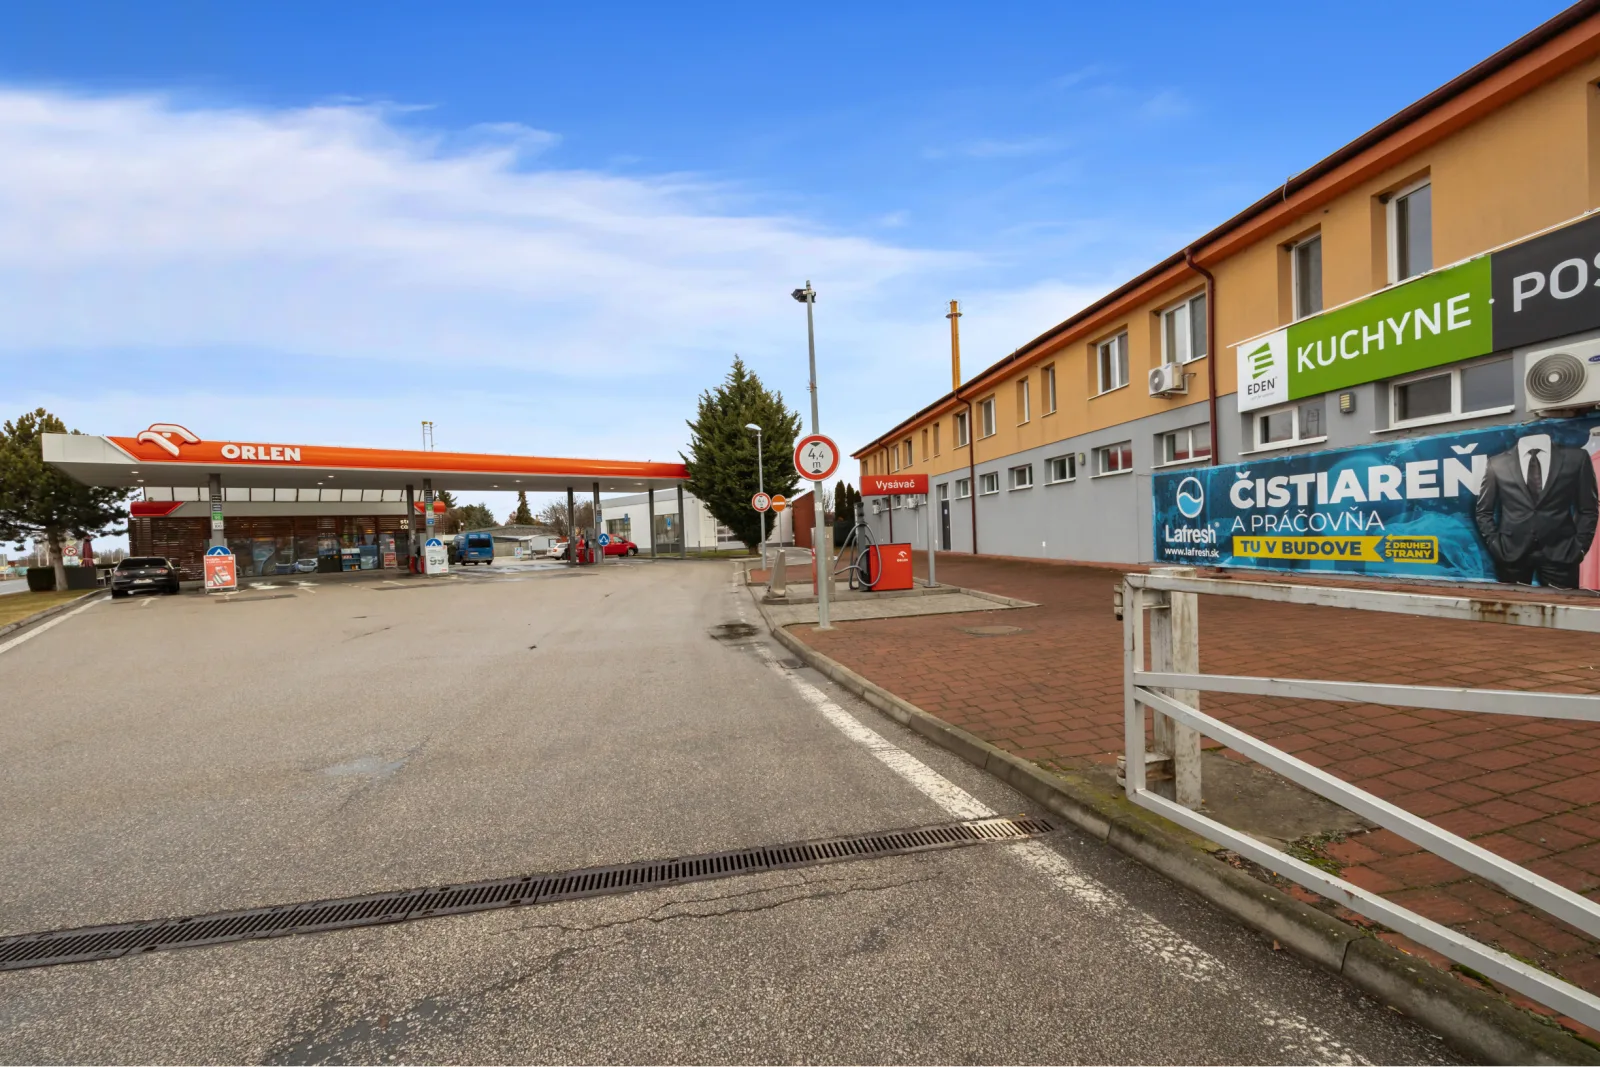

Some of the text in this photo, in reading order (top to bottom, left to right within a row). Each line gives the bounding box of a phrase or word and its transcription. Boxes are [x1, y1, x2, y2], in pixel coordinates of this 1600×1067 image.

[1513, 252, 1600, 313] PO
[1297, 292, 1472, 373] KUCHYNE
[1248, 378, 1275, 395] EDEN
[221, 444, 301, 461] ORLEN
[808, 447, 824, 460] 4,4
[812, 461, 821, 469] m
[1230, 442, 1488, 509] ČISTIAREŇ
[875, 479, 915, 491] Vysávač
[1231, 506, 1386, 532] A PRÁČOVŇA
[1165, 524, 1217, 544] Lafresh
[1165, 547, 1219, 557] www.lafresh.sk
[1240, 541, 1362, 556] TU V BUDOVE
[1384, 541, 1431, 549] Z DRUHEJ
[1385, 549, 1431, 558] STRANY
